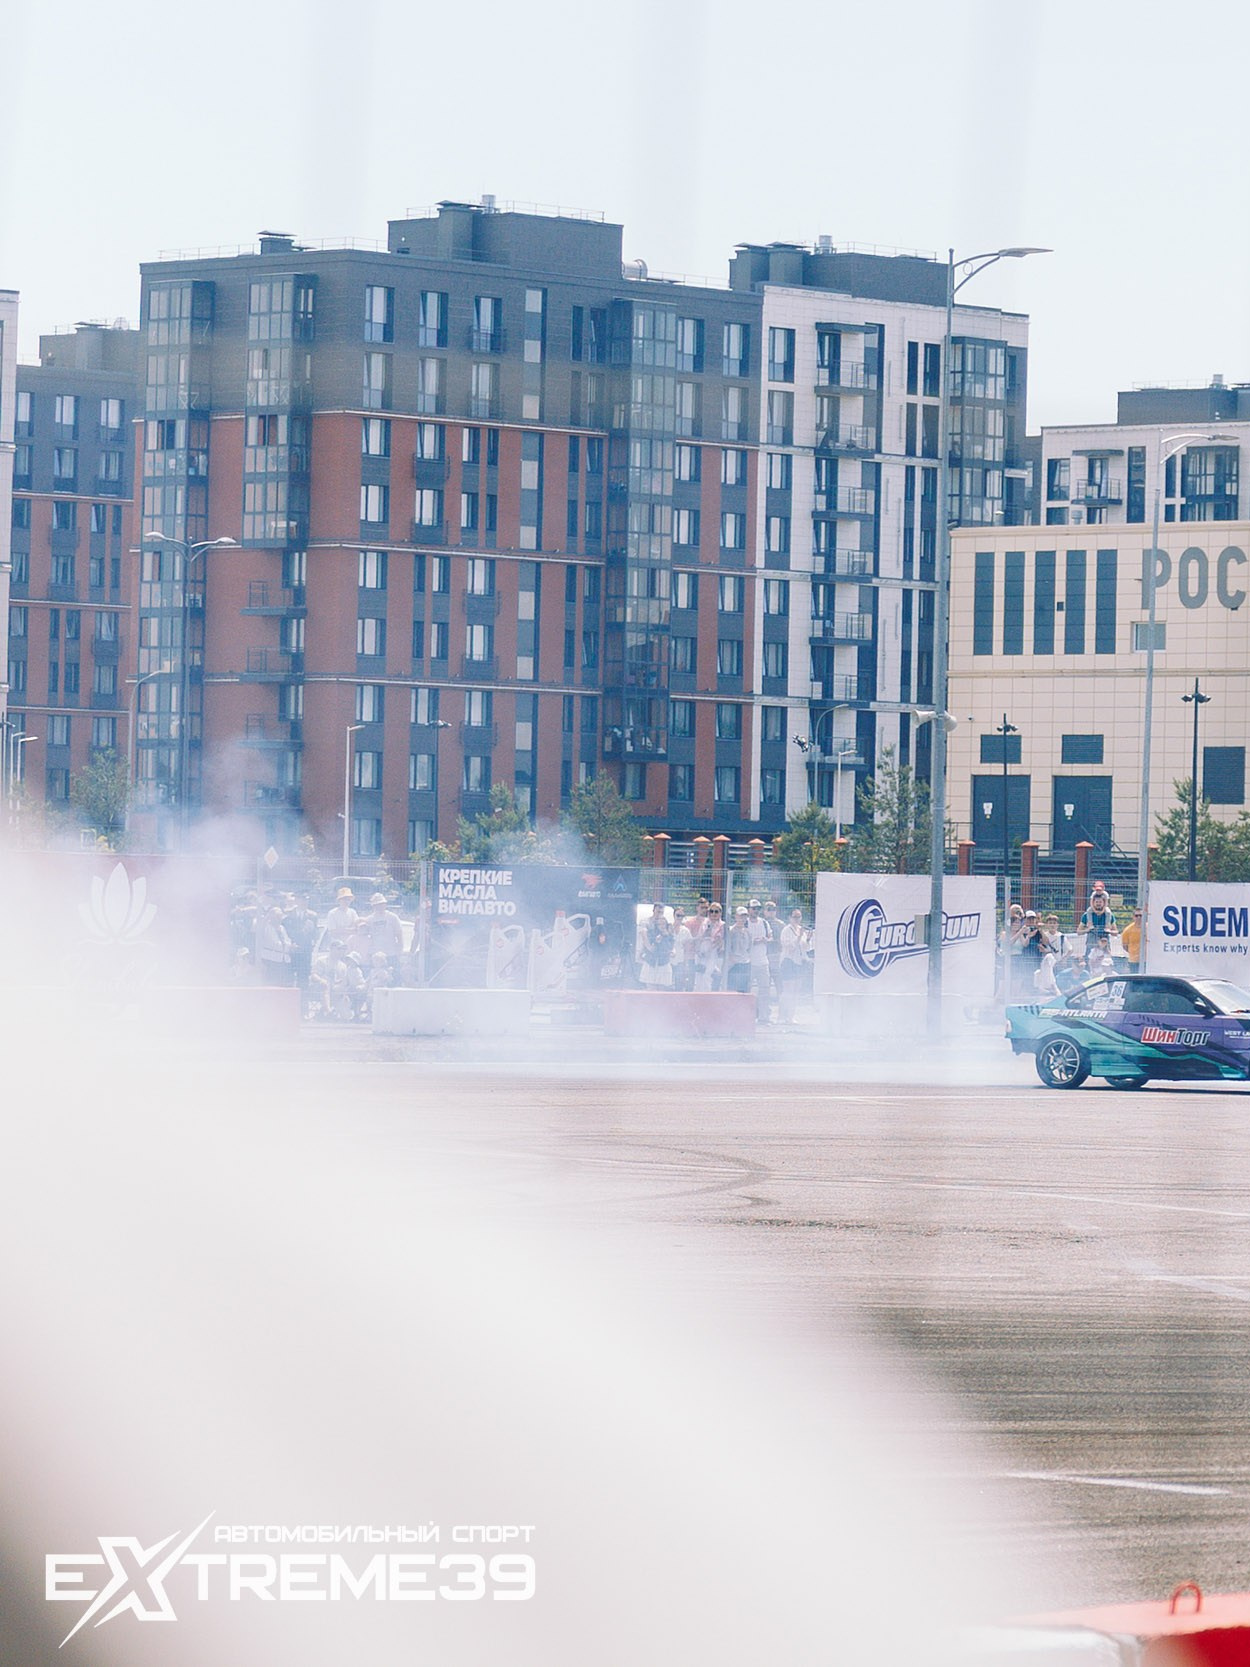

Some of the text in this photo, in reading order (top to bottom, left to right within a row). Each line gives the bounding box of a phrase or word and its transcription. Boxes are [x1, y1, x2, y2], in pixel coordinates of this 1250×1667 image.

[439, 868, 513, 886] КРЕПКИЕ
[439, 884, 497, 900] МАСЛА
[438, 899, 517, 917] ВМПАВТО
[1162, 905, 1248, 938] SIDEM
[1163, 942, 1248, 956] Experts know why
